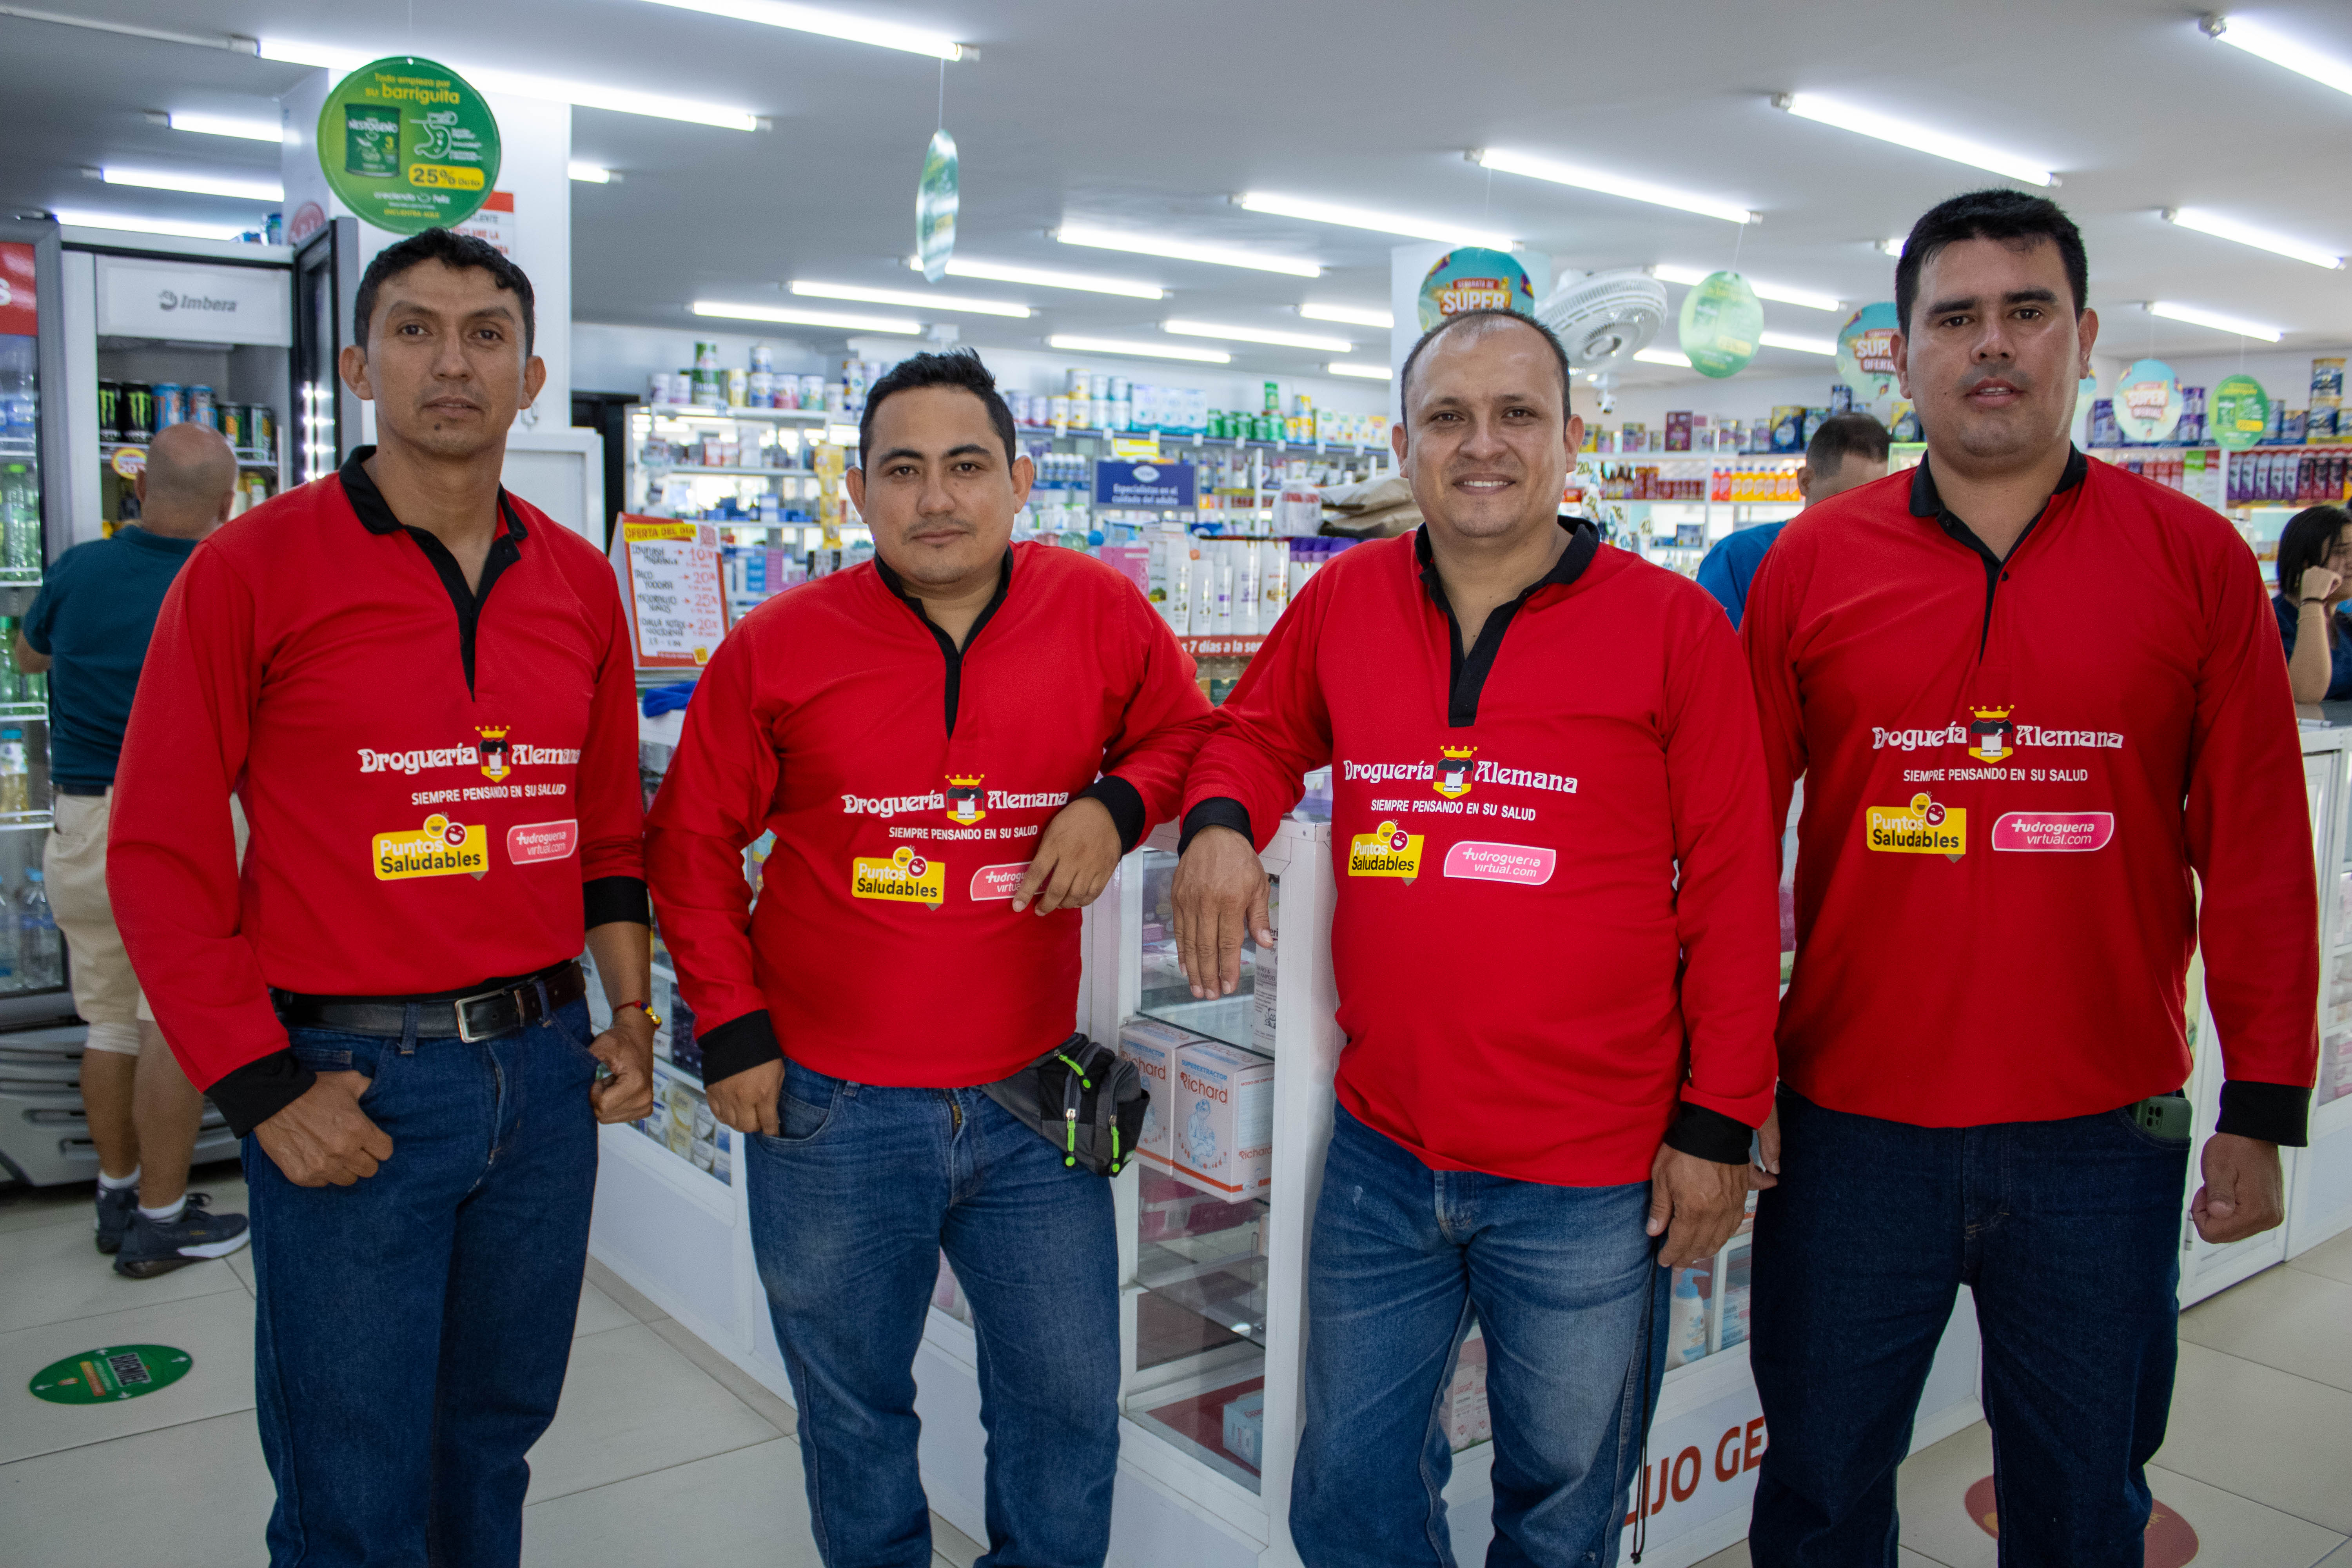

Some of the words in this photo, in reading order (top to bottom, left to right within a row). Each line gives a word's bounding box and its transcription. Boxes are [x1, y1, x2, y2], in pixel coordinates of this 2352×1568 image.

[365, 87, 378, 97] su
[382, 84, 460, 105] barriguita
[385, 136, 394, 150] 3
[413, 167, 456, 185] 25%
[180, 295, 238, 312] Imbera
[625, 527, 659, 539] OFERTA
[661, 527, 677, 536] DEL
[1190, 640, 1198, 653] 7
[1223, 642, 1230, 653] a
[1232, 640, 1243, 653] la
[2016, 725, 2124, 749] Alemana
[357, 742, 479, 775] Droguería
[1343, 760, 1435, 783] Droguería
[1474, 760, 1578, 794] Alemana
[1904, 769, 1945, 782] SIEMPRE
[1948, 768, 2007, 781] PENSANDO
[2010, 768, 2025, 781] EN
[2031, 769, 2045, 782] SU
[2049, 769, 2088, 782] SALUD
[412, 789, 461, 806] SIEMPRE
[463, 785, 508, 801] PENSANDO
[510, 785, 522, 797] EN
[524, 785, 536, 797] SU
[537, 784, 566, 796] SALUD
[841, 789, 945, 818] Droguería
[987, 791, 1068, 809] Alemana
[1371, 799, 1410, 812] SIEMPRE
[1412, 801, 1463, 814] PENSANDO
[1466, 802, 1479, 815] EN
[1482, 804, 1497, 816] SU
[1501, 806, 1536, 821] SALUD
[889, 826, 929, 839] SIEMPRE
[931, 828, 981, 840] PENSANDO
[984, 828, 996, 840] EN
[1000, 827, 1011, 838] SU
[1013, 825, 1038, 837] SALUD
[1873, 812, 1924, 833] Puntos
[380, 837, 445, 858] Puntos
[1354, 840, 1388, 857] Puntos
[1873, 829, 1959, 849] Saludables
[2027, 833, 2092, 846] virtual.com
[381, 851, 481, 874] Saludables
[858, 863, 906, 881] Puntos
[1352, 855, 1414, 872] Saludables
[1474, 862, 1537, 877] virtual.com
[857, 878, 937, 898] Saludables
[1182, 1059, 1228, 1081] SUPEREXTRACTOR
[1180, 1072, 1228, 1104] Richard
